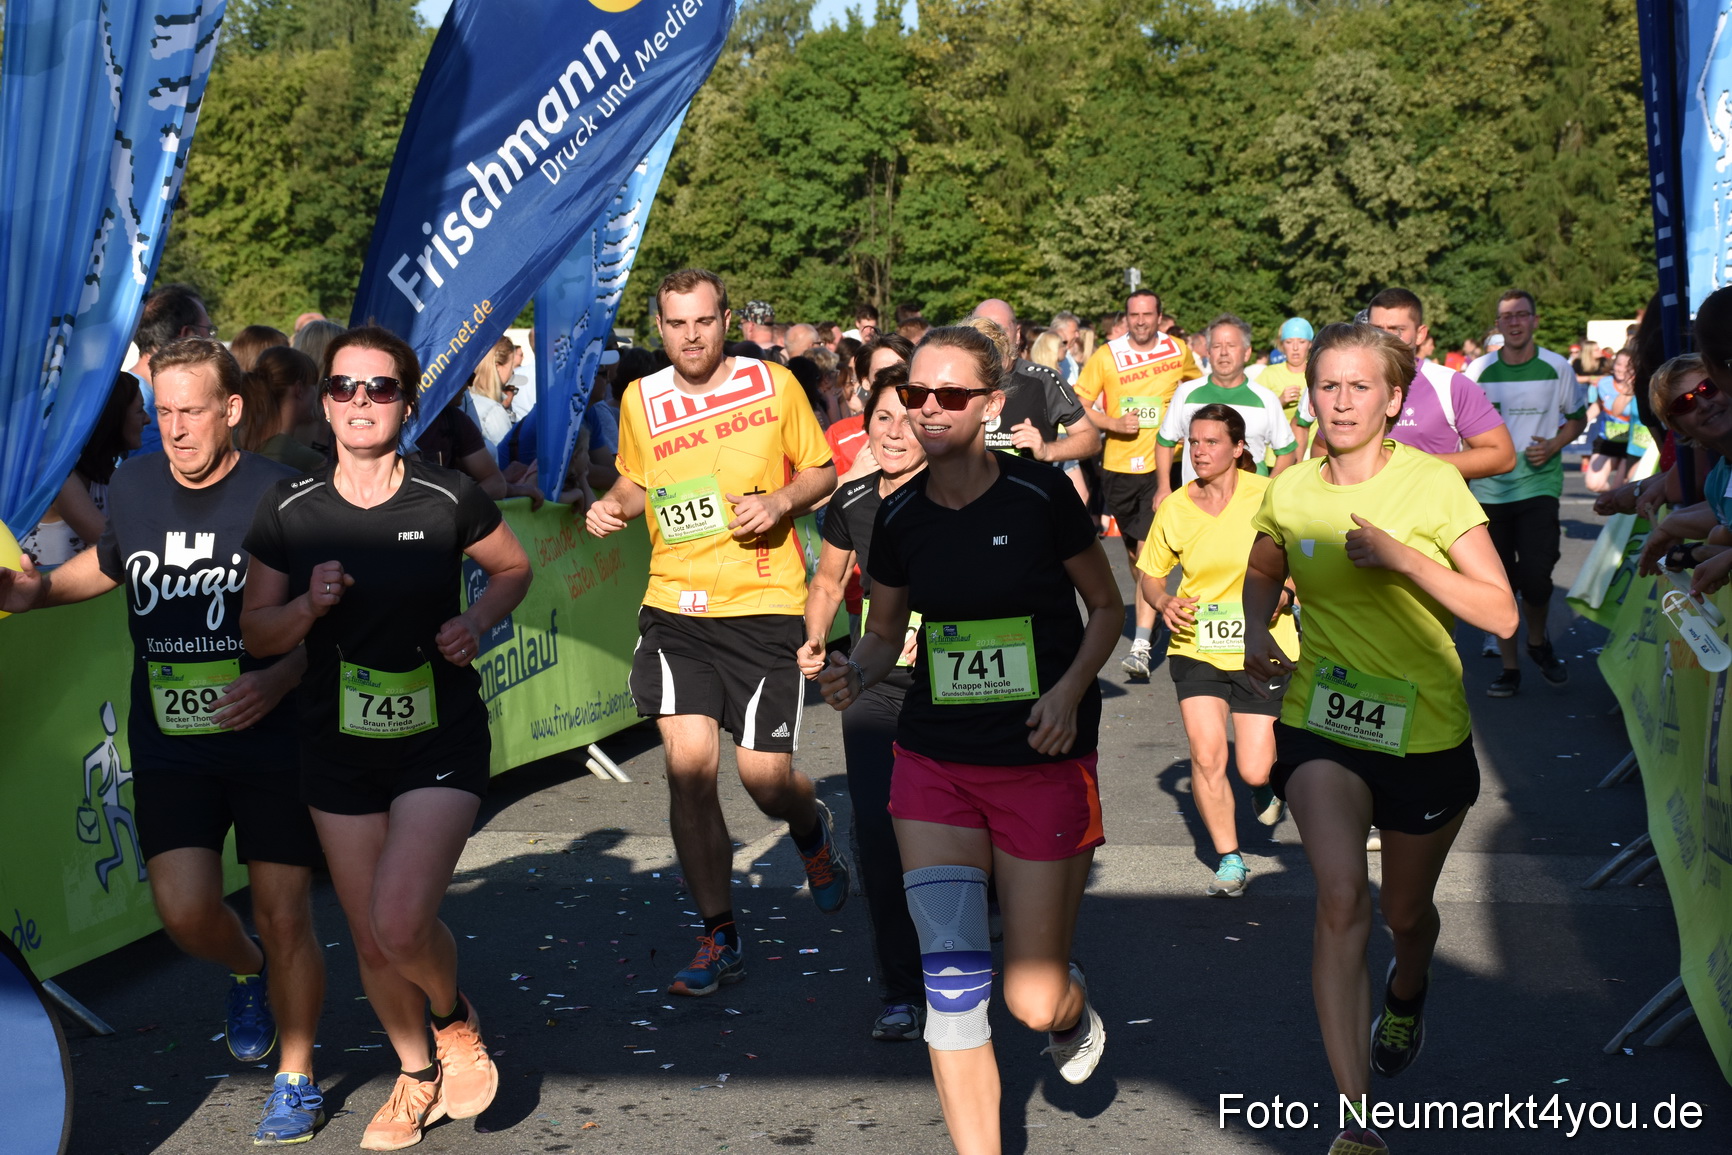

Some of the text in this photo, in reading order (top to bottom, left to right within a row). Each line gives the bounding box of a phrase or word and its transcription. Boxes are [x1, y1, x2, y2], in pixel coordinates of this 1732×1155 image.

[540, 115, 598, 185] Druck
[597, 63, 637, 118] und
[387, 29, 621, 313] Frischmann
[1119, 360, 1183, 385] MAX BÖGL
[653, 406, 779, 462] MAX BÖGL
[299, 477, 314, 487] JAKO
[660, 496, 714, 528] 1315
[398, 530, 424, 541] FRIEDA
[685, 520, 707, 530] Michael
[992, 534, 1008, 546] NICI
[126, 550, 248, 631] Burgi
[1204, 620, 1243, 639] 162
[146, 635, 246, 653] Knödelliebe
[947, 648, 1005, 681] 741
[952, 679, 1011, 692] Knappe Nicole
[994, 687, 1025, 695] Bräugasse
[164, 688, 219, 715] 269
[358, 692, 415, 720] 743
[1326, 692, 1386, 730] 944
[165, 715, 190, 723] Becker
[363, 719, 412, 728] Braun Frieda
[1324, 718, 1352, 733] Maurer
[1353, 726, 1384, 739] Daniela
